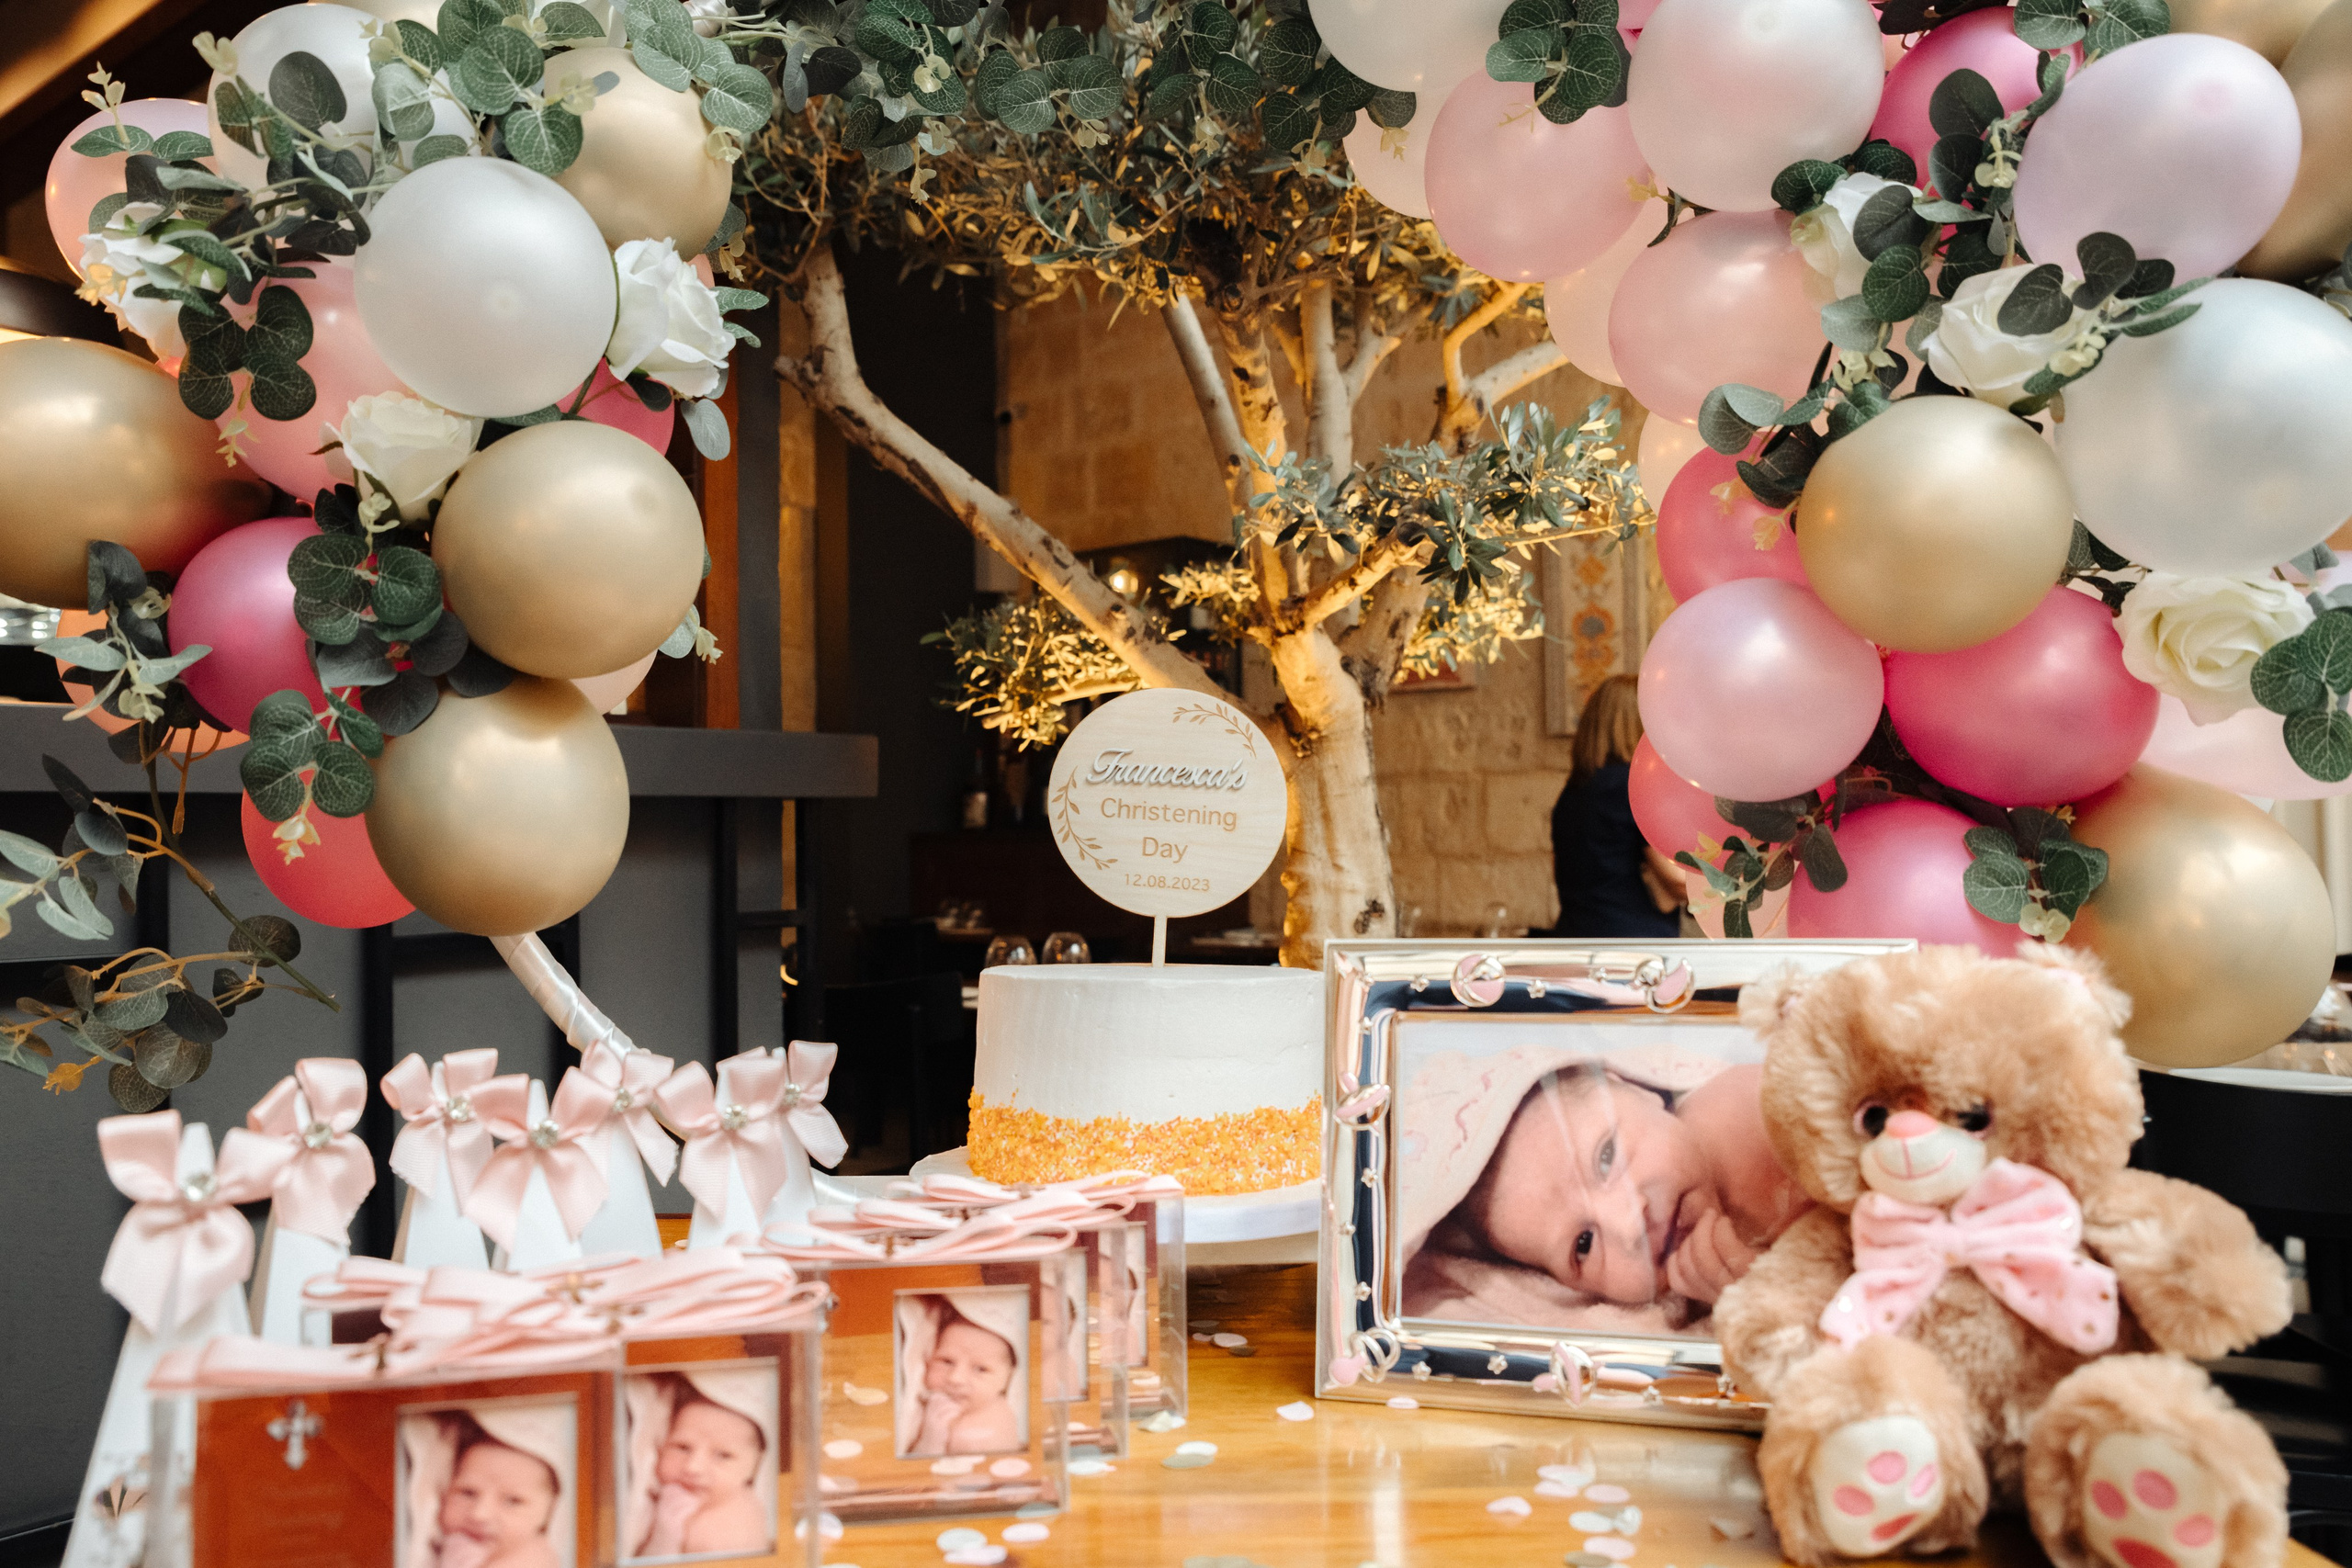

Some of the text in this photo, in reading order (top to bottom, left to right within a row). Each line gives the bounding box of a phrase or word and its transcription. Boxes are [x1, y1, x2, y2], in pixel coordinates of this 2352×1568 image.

[1087, 750, 1248, 789] Francesca's
[1102, 798, 1237, 831] Christening
[1143, 838, 1188, 863] Day
[1125, 874, 1210, 891] 12.08.2023
